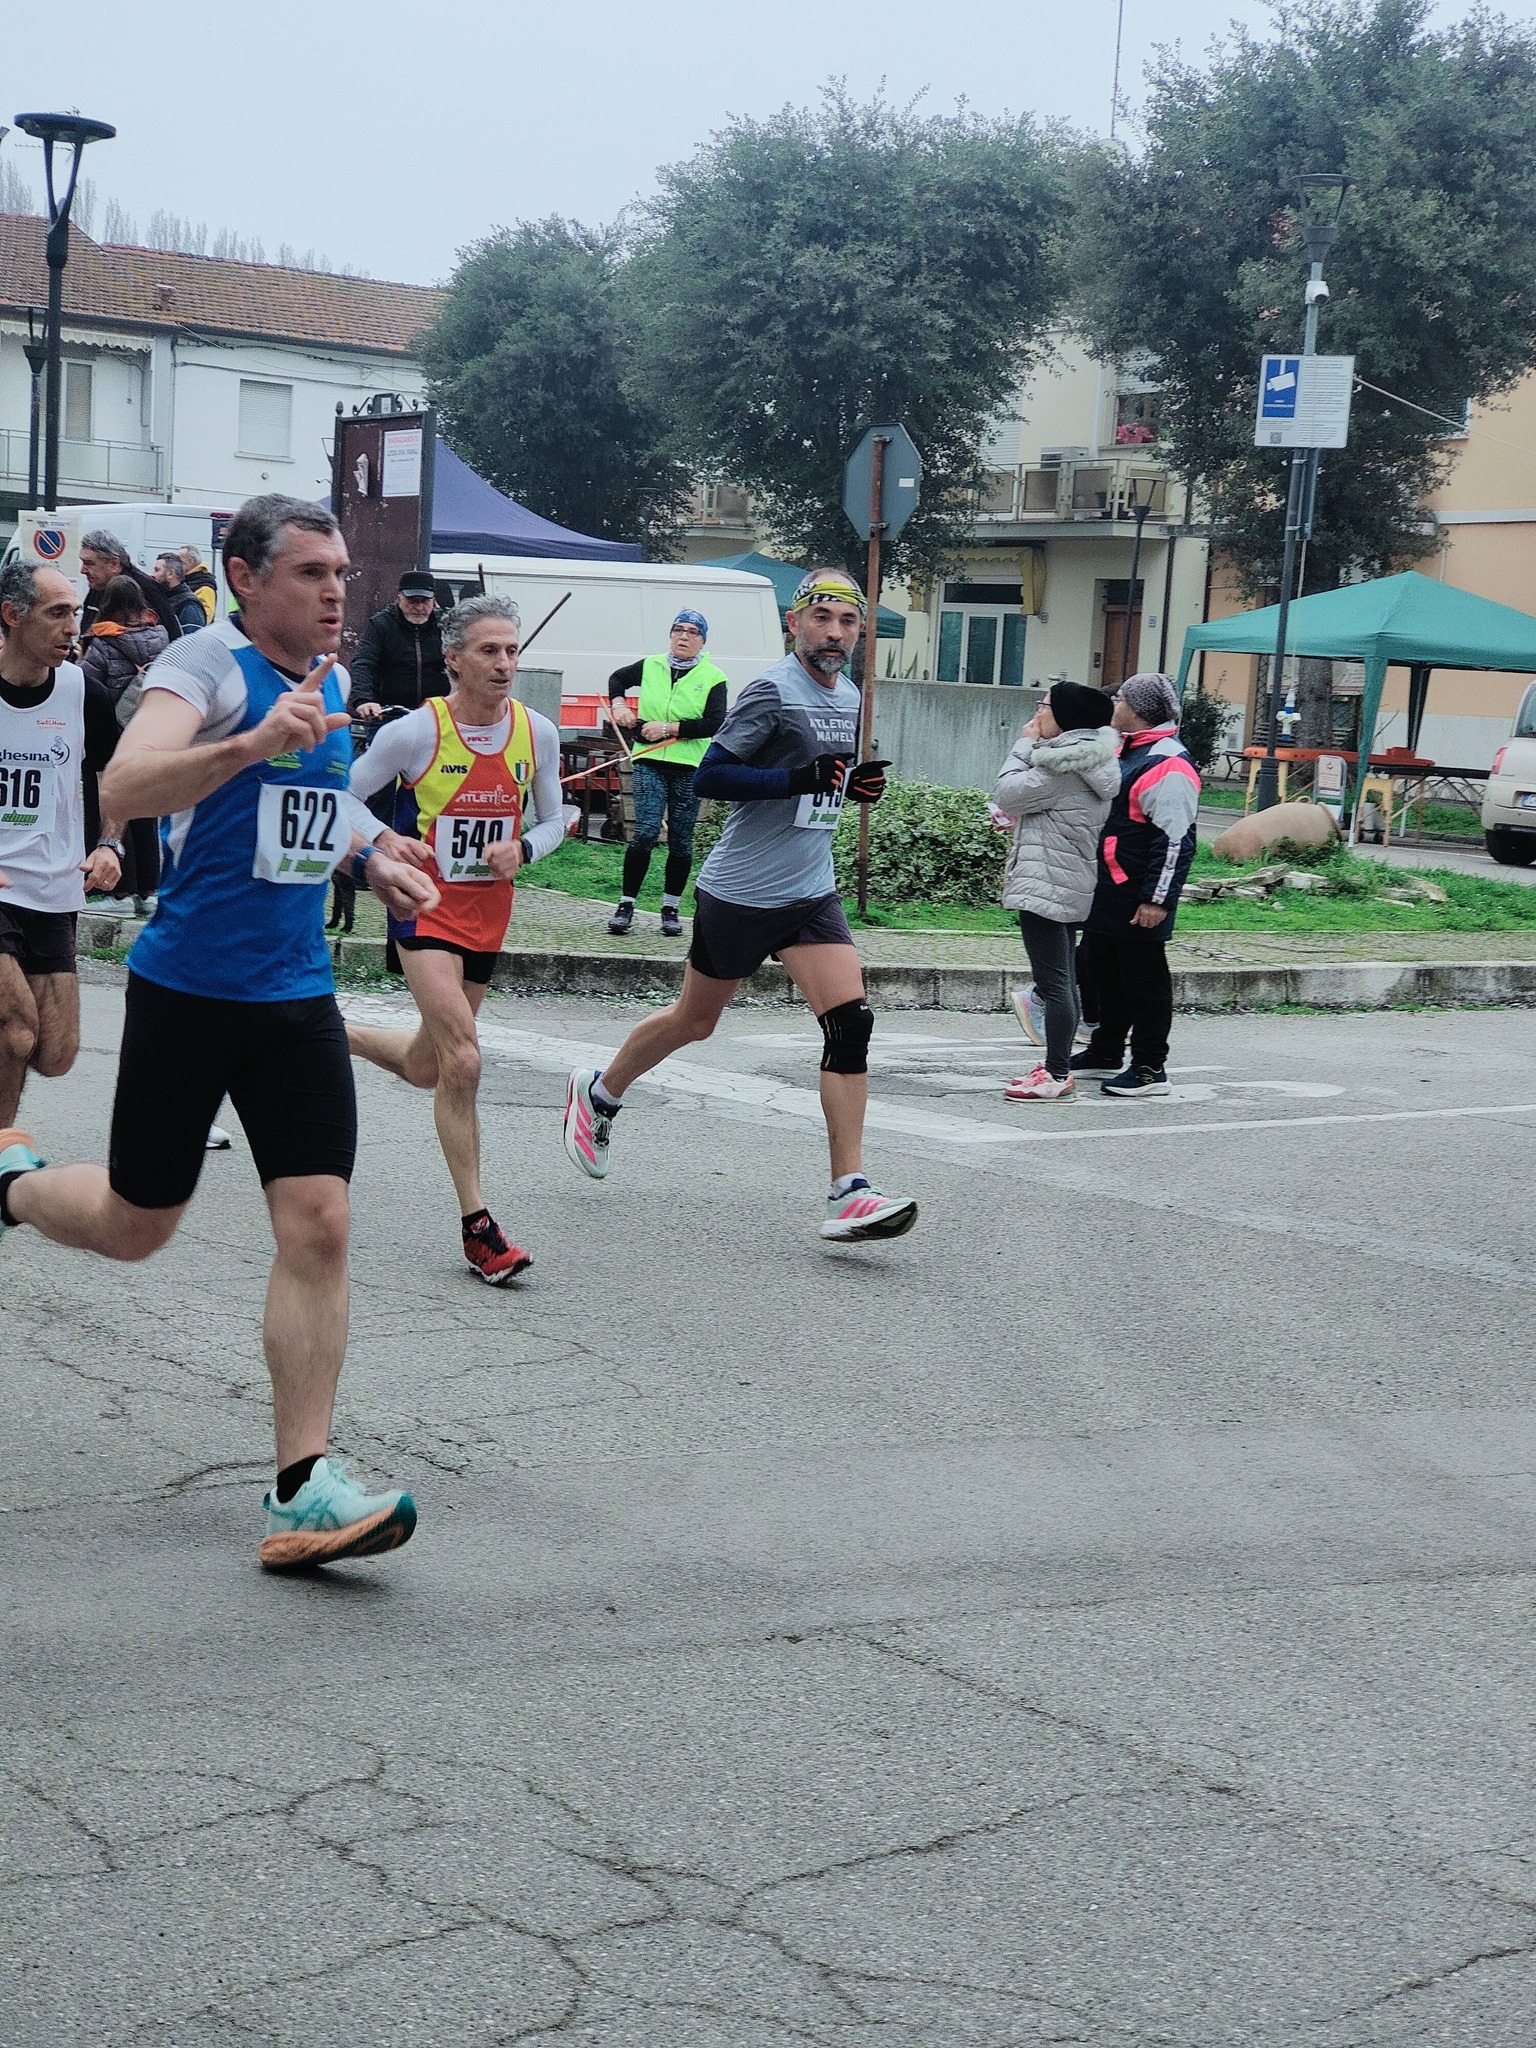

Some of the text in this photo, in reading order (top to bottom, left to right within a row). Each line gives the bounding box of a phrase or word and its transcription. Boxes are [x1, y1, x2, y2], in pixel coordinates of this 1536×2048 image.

[809, 718, 856, 730] ATLETICA
[0, 749, 50, 763] hesina
[440, 764, 468, 774] AVIS
[281, 789, 337, 851] 622
[451, 819, 503, 859] 540
